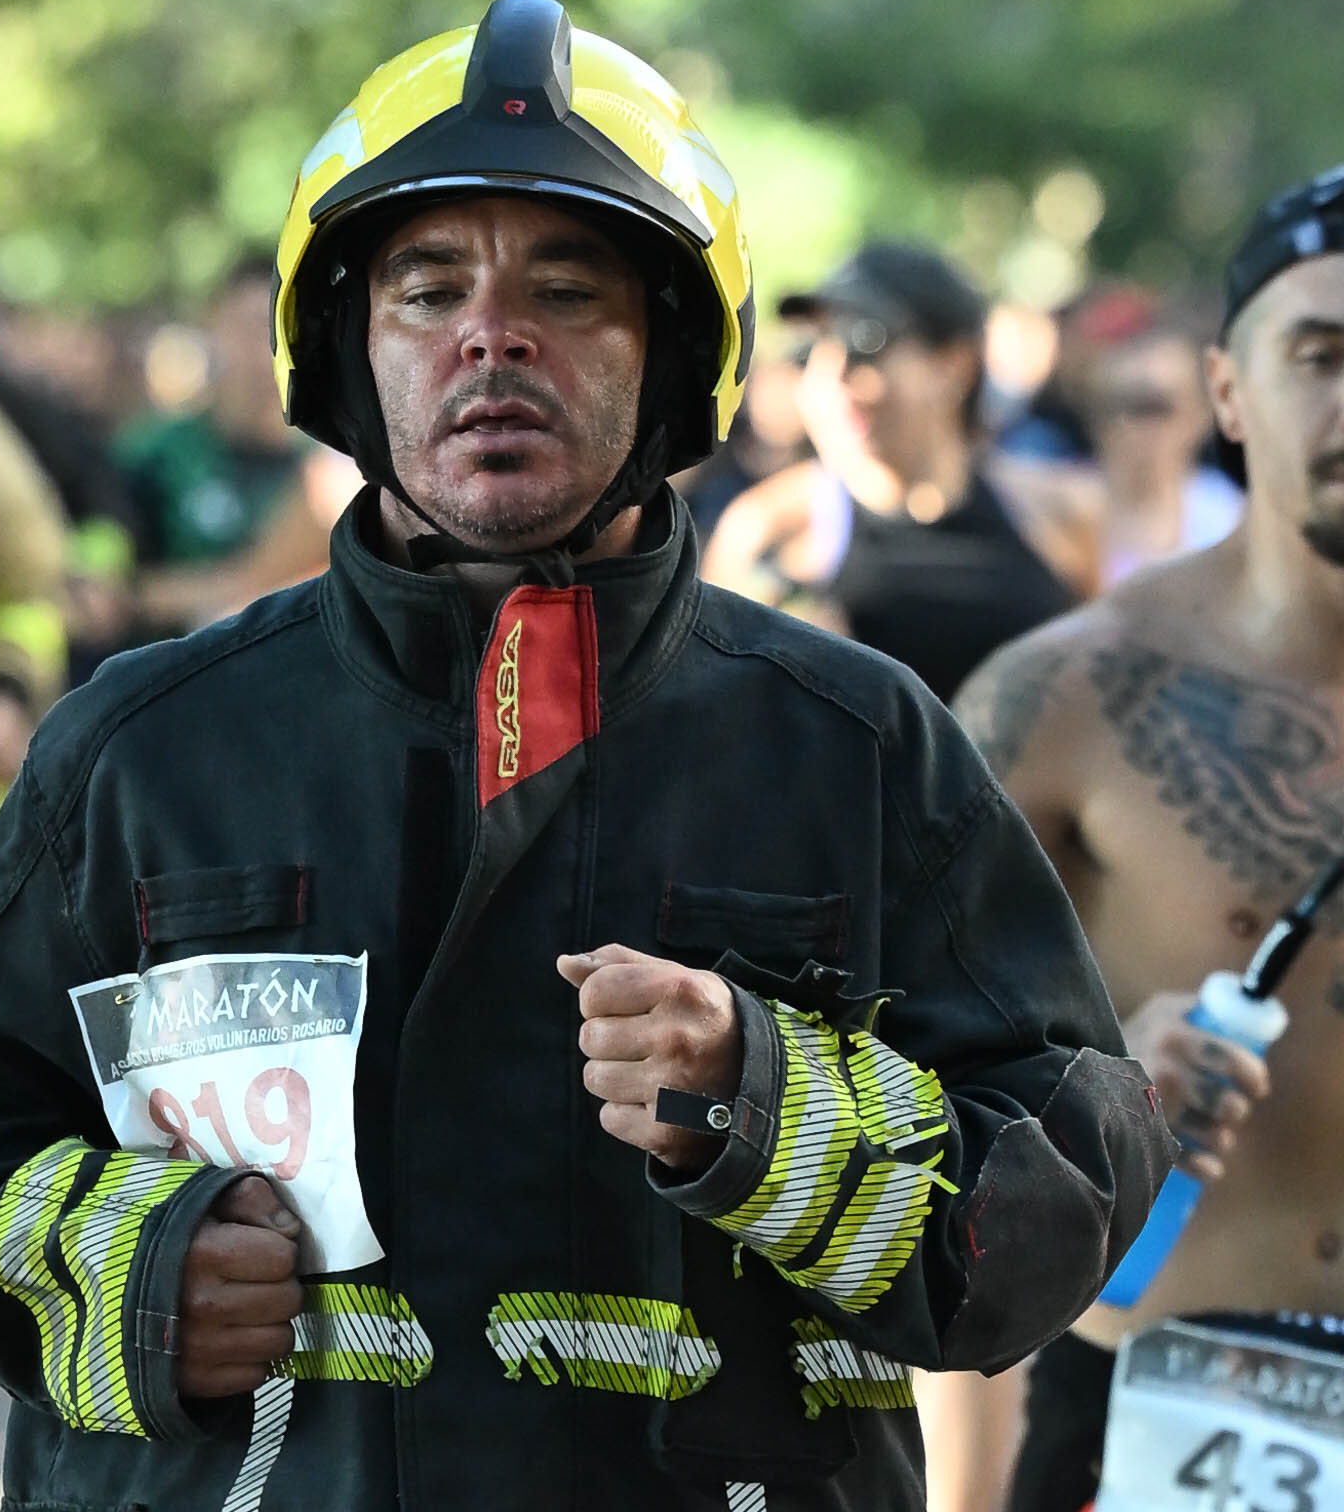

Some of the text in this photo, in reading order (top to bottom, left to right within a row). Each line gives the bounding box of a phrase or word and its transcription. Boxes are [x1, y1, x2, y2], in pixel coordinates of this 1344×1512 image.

[496, 619, 523, 778] RASA
[147, 967, 318, 1036] MARATÓN
[207, 1026, 288, 1052] VOLUNTARIOS
[292, 1017, 346, 1039] ROSARIO
[148, 1067, 311, 1181] 819
